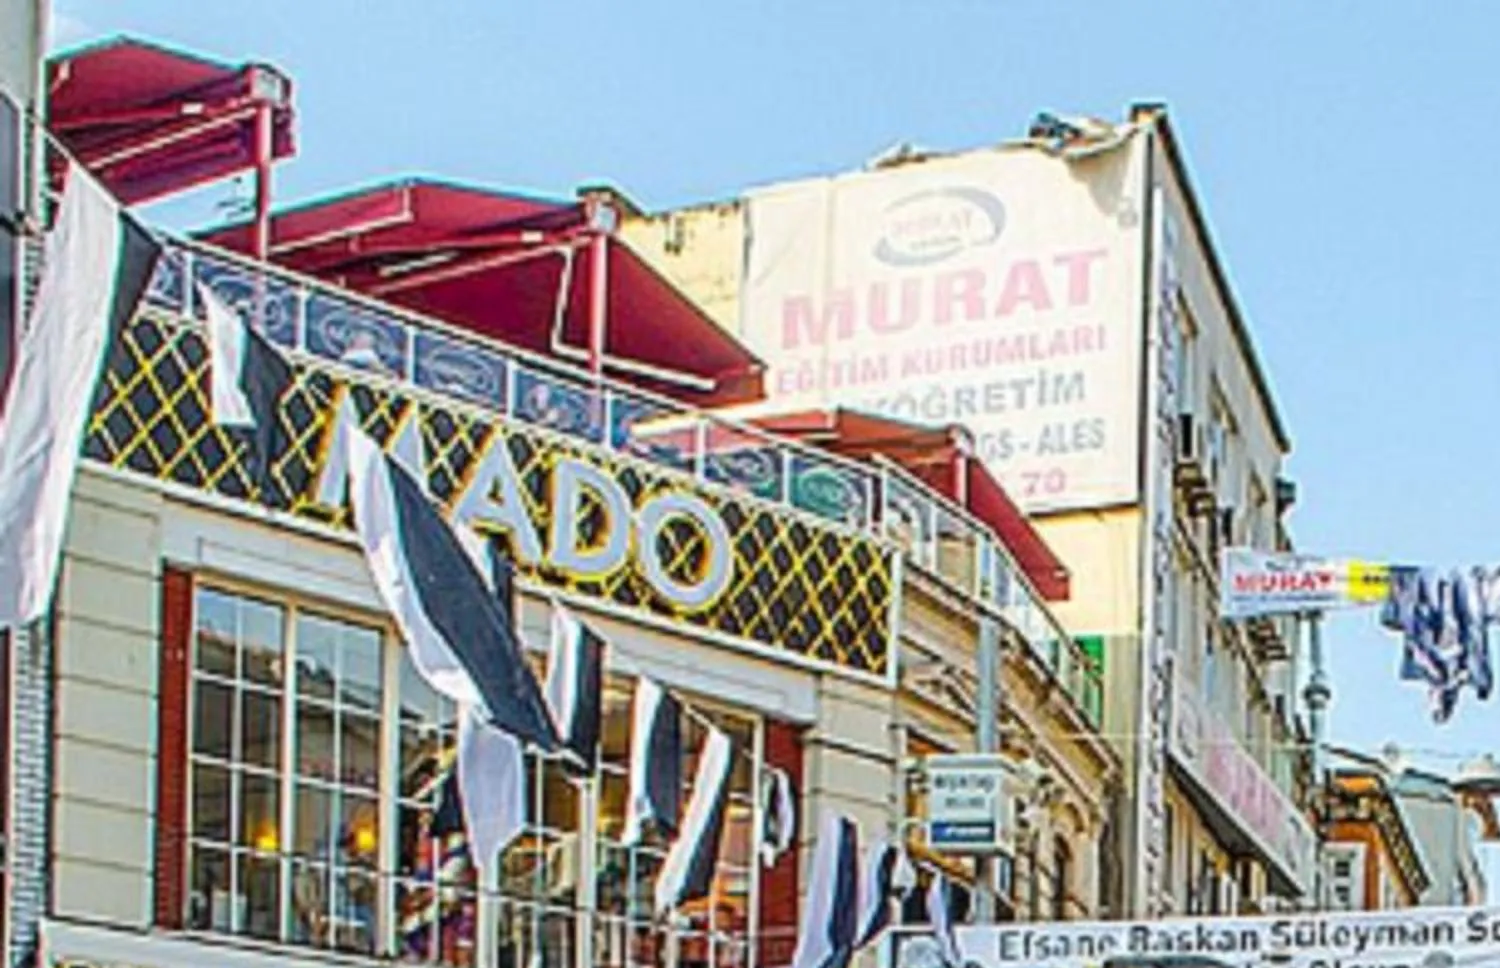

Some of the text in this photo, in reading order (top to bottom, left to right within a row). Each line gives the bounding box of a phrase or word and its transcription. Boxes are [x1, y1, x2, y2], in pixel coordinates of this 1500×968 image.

[782, 248, 1109, 350] MURAT
[901, 324, 1107, 380] KURUMLARI
[1233, 570, 1333, 593] MURAT
[999, 929, 1119, 961] Efsane
[1269, 918, 1455, 952] Süleyman
